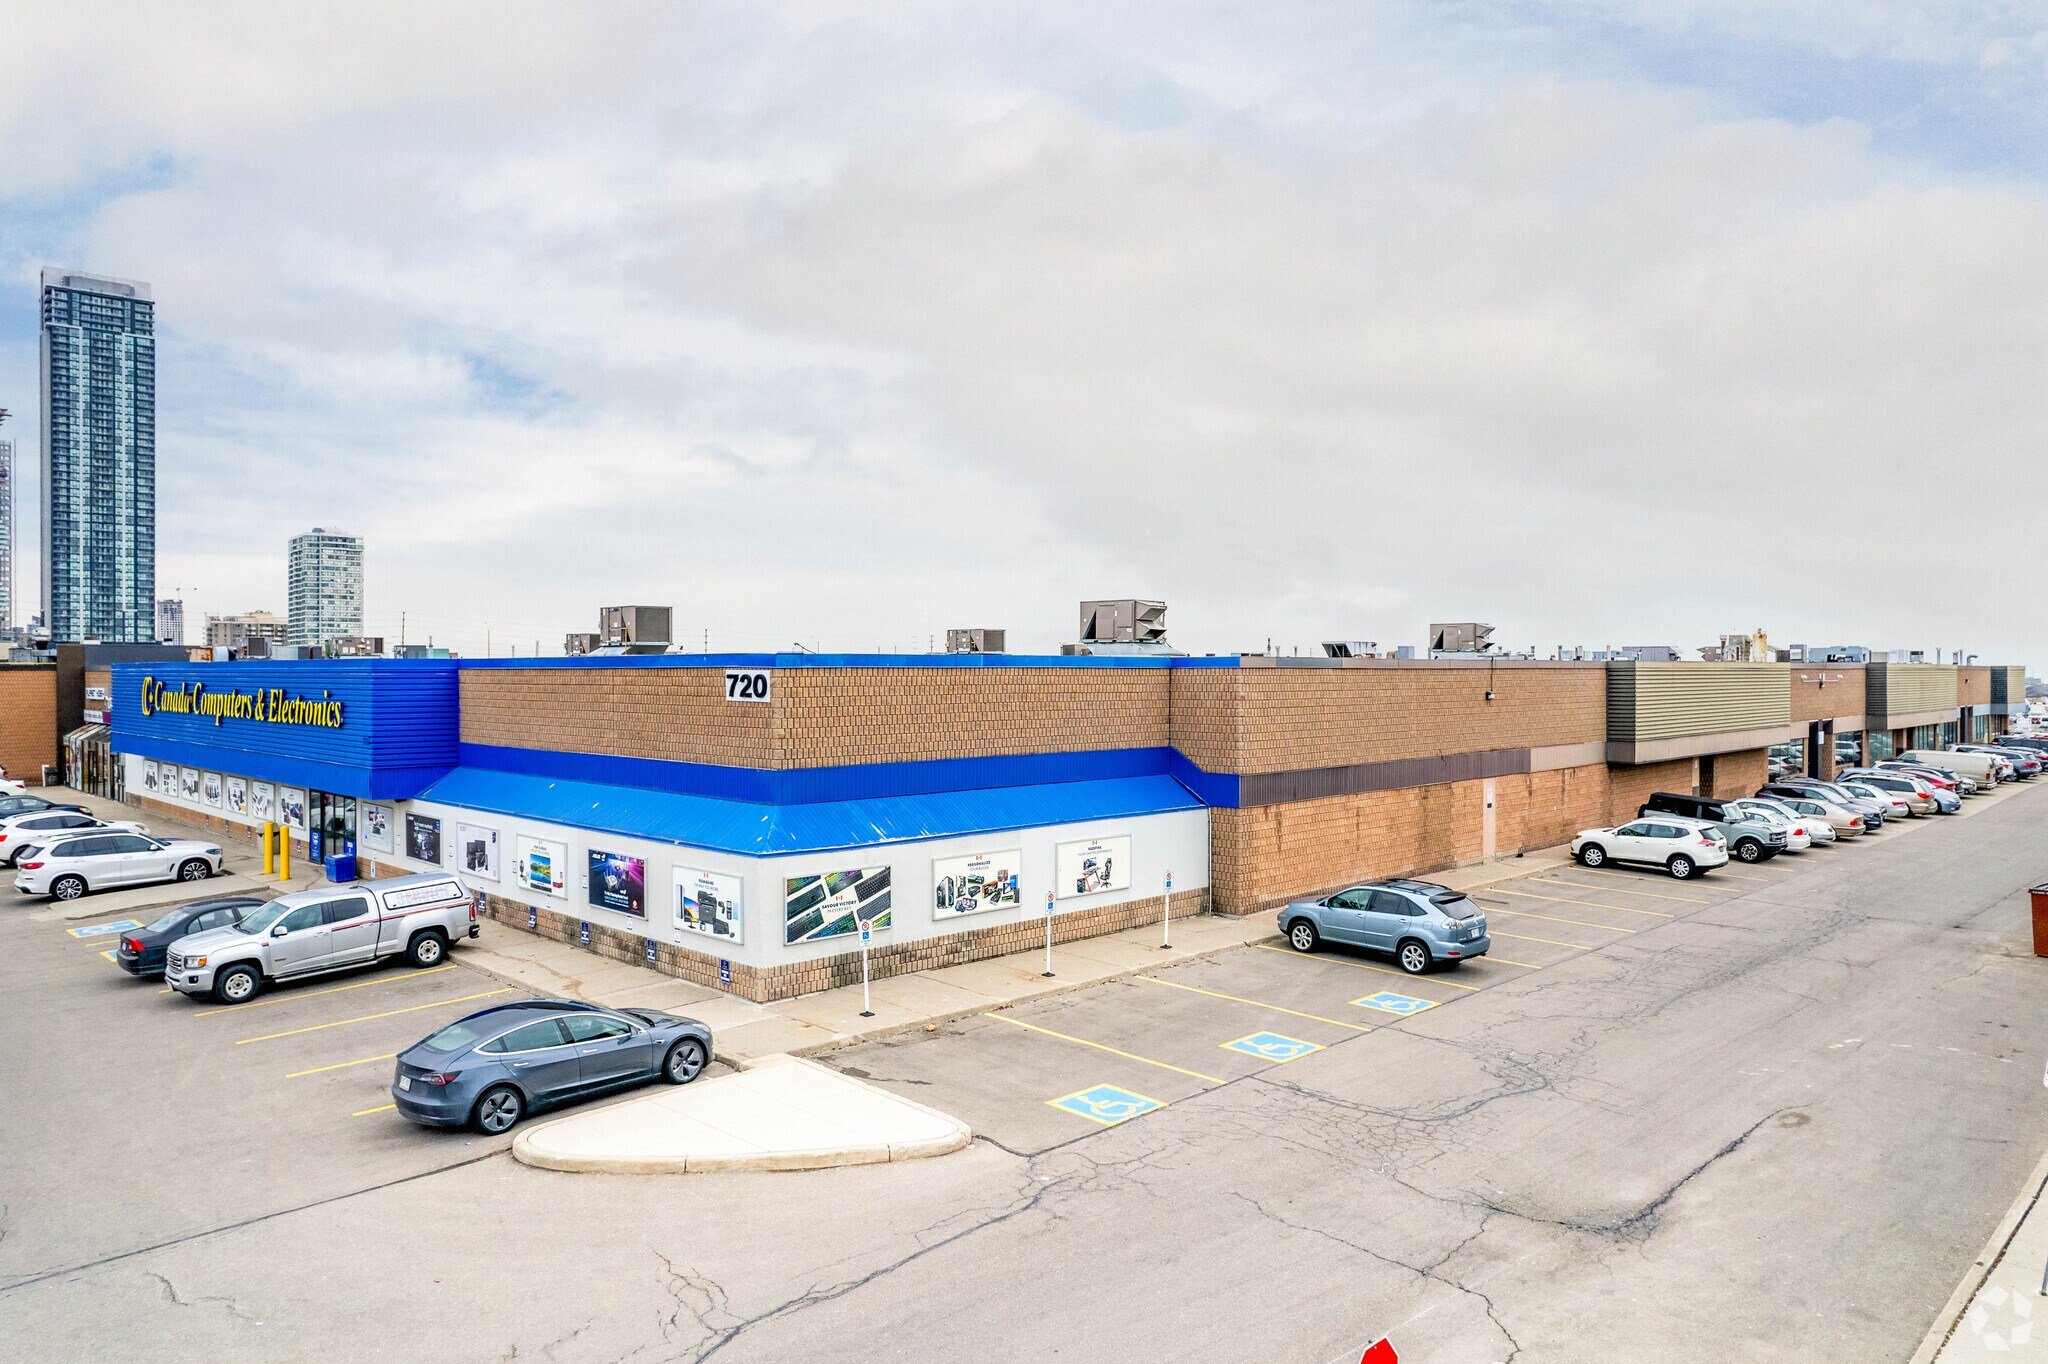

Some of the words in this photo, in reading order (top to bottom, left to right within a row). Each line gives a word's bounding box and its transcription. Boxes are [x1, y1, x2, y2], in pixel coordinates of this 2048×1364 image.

[726, 674, 767, 698] 720
[154, 681, 190, 714] Canada
[193, 682, 253, 726] Computers
[254, 688, 265, 721] &
[267, 688, 342, 728] Electronics
